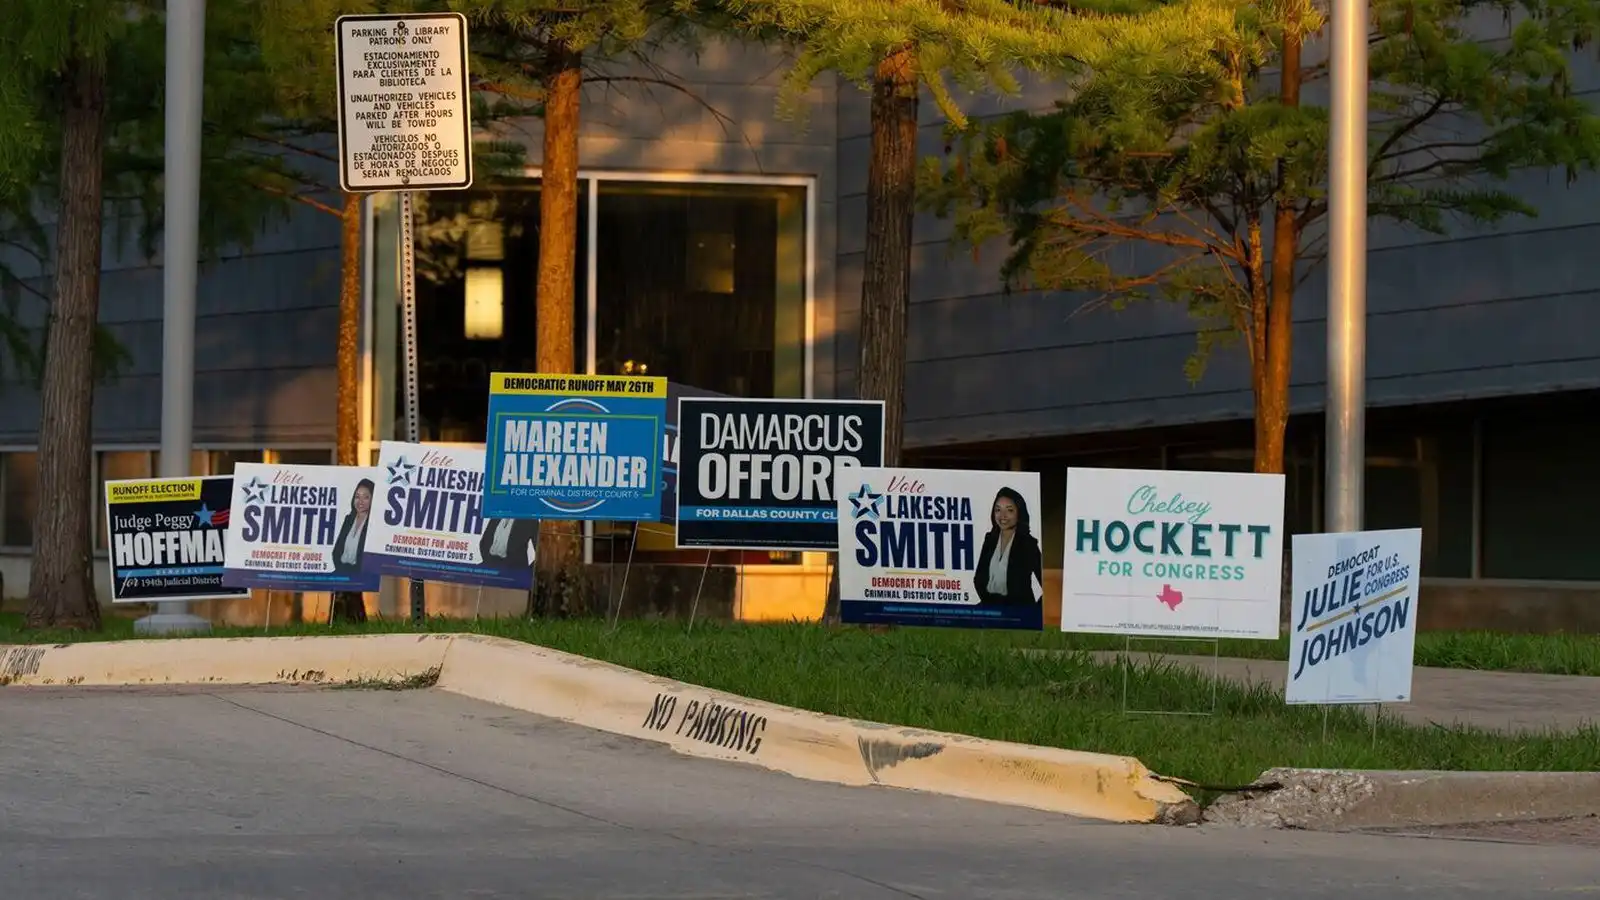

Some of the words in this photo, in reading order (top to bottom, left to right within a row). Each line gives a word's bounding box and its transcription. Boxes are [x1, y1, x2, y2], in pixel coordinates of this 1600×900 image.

[352, 28, 387, 37] PARKING
[393, 28, 409, 36] FOR
[415, 27, 450, 35] LIBRARY
[369, 37, 406, 45] PATRONS
[412, 36, 433, 44] ONLY
[364, 51, 440, 61] ESTACIONAMIENTO
[367, 60, 437, 69] EXCLUSIVAMENTE
[381, 69, 419, 77] CLIENTES
[441, 68, 452, 76] LA
[379, 79, 426, 87] BIBLIOTECA
[350, 93, 413, 102] UNAUTHORIZED
[418, 92, 457, 100] VEHICLES
[397, 101, 435, 109] VEHICLES
[356, 112, 387, 120] PARKED
[393, 111, 419, 119] AFTER
[425, 110, 453, 118] HOURS
[391, 120, 402, 128] BE
[408, 119, 437, 127] TOWED
[374, 135, 419, 143] VEHICULOS
[371, 143, 429, 152] AUTORIZADOS
[353, 151, 416, 161] ESTACIONADOS
[422, 150, 458, 159] DESPUES
[370, 161, 399, 169] HORAS
[421, 159, 459, 167] NEGOCIO
[362, 170, 390, 178] SERAN
[396, 168, 452, 177] REMOLCADOS
[504, 378, 565, 390] DEMOCRATIC
[568, 380, 605, 392] RUNOFF
[606, 381, 626, 392] MAY
[628, 381, 654, 393] 26TH
[504, 420, 607, 454] MAREEN
[700, 413, 863, 452] DAMARCUS
[420, 449, 453, 467] Vote
[273, 470, 304, 484] Vote
[500, 454, 648, 488] ALEXANDER
[112, 485, 148, 495] RUNOFF
[151, 483, 195, 493] ELECTION
[887, 475, 926, 494] Vote
[270, 485, 337, 506] LAKESHA
[511, 488, 528, 496] FOR
[529, 489, 565, 497] CRIMINAL
[604, 490, 632, 498] COURT
[384, 486, 483, 535] SMITH
[886, 495, 972, 521] LAKESHA
[1127, 485, 1212, 525] Chelsey
[696, 509, 720, 517] FOR
[723, 509, 767, 518] DALLAS
[770, 510, 819, 519] COUNTY
[114, 514, 152, 531] Judge
[155, 513, 195, 529] Peggy
[242, 505, 337, 545] SMITH
[393, 534, 431, 547] DEMOCRAT
[432, 537, 444, 548] FOR
[446, 539, 468, 551] JUDGE
[855, 520, 974, 571] SMITH
[1076, 519, 1271, 558] HOCKETT
[251, 550, 286, 559] DEMOCRAT
[288, 552, 300, 560] FOR
[303, 552, 322, 561] JUDGE
[385, 544, 415, 555] CRIMINAL
[417, 547, 445, 558] DISTRICT
[447, 549, 467, 560] COURT
[244, 559, 273, 568] CRIMINAL
[275, 561, 301, 569] DISTRICT
[303, 562, 322, 570] COURT
[1328, 545, 1380, 578] DEMOCRAT
[1366, 560, 1383, 579] FOR
[1385, 553, 1400, 570] U.S.
[1098, 561, 1133, 577] FOR
[1143, 562, 1245, 580] CONGRESS
[120, 571, 139, 596] for
[141, 579, 162, 587] 194th
[164, 577, 191, 587] Judicial
[192, 575, 219, 584] District
[872, 577, 915, 589] DEMOCRAT
[918, 578, 933, 589] FOR
[935, 579, 961, 590] JUDGE
[1364, 565, 1410, 596] CONGRESS
[864, 589, 900, 599] CRIMINAL
[903, 590, 935, 600] DISTRICT
[938, 591, 962, 601] COURT
[963, 592, 969, 601] 5
[1297, 569, 1364, 632] JULIE
[1294, 596, 1410, 681] JOHNSON
[642, 693, 677, 731] NO
[675, 699, 767, 754] PARKING
